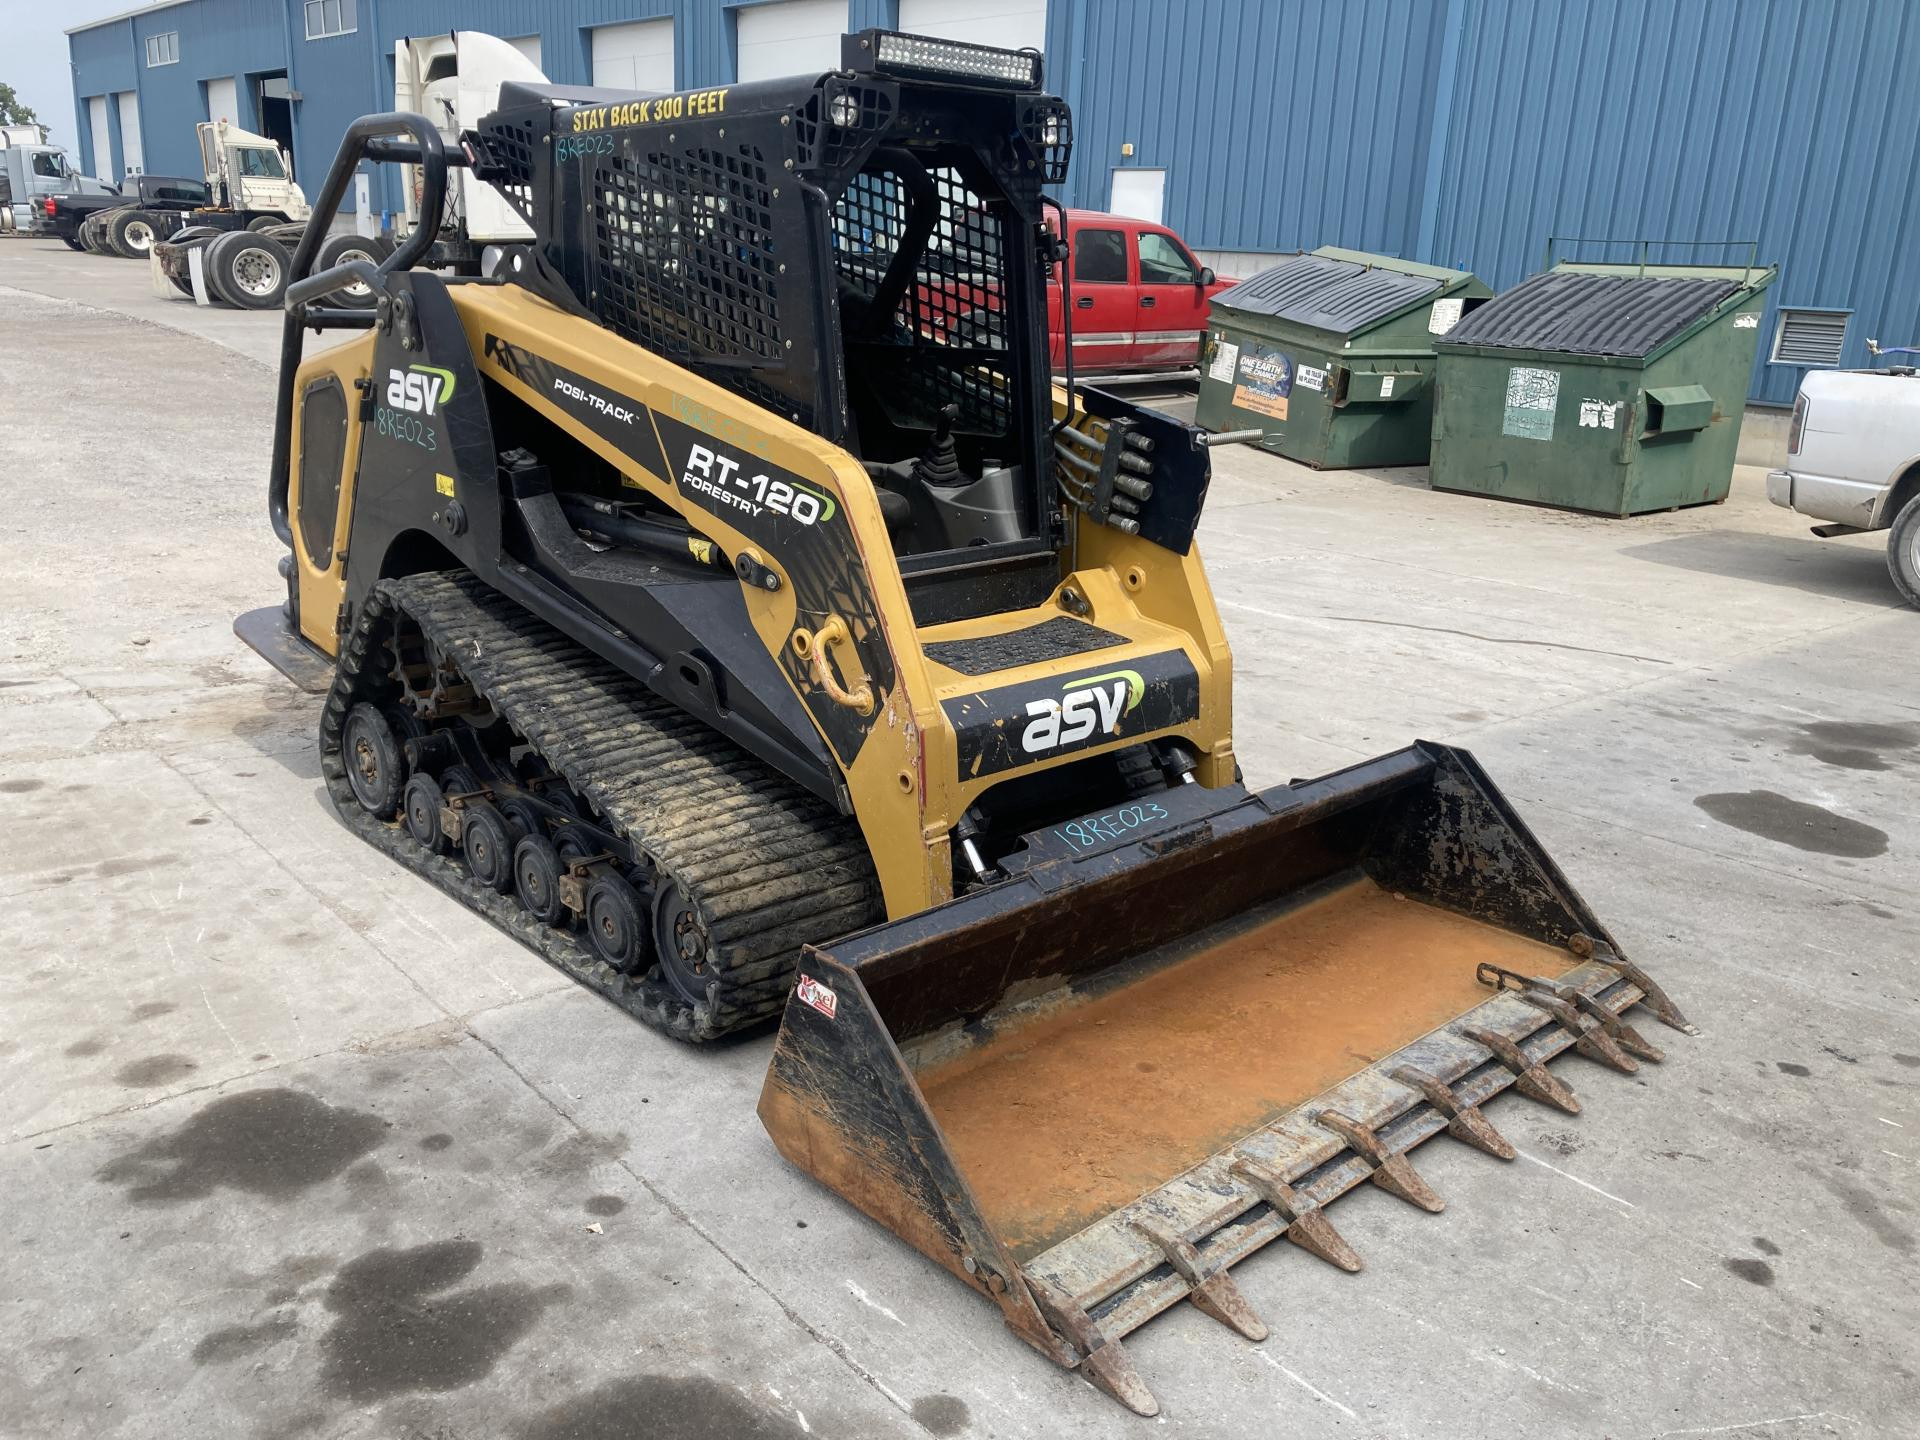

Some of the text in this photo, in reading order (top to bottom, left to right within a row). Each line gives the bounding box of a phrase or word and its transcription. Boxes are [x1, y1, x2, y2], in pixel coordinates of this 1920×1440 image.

[573, 89, 729, 132] STAY BACK 300 FEET
[555, 134, 615, 167] 18RE023
[1240, 356, 1282, 375] ONE EARTH
[1253, 368, 1277, 381] CHANCE
[554, 378, 635, 425] POSI-TRACK
[373, 406, 437, 451] 18RE023
[682, 471, 763, 517] FORESTRY
[686, 443, 820, 526] RT-120
[1053, 803, 1168, 853] 18RE023
